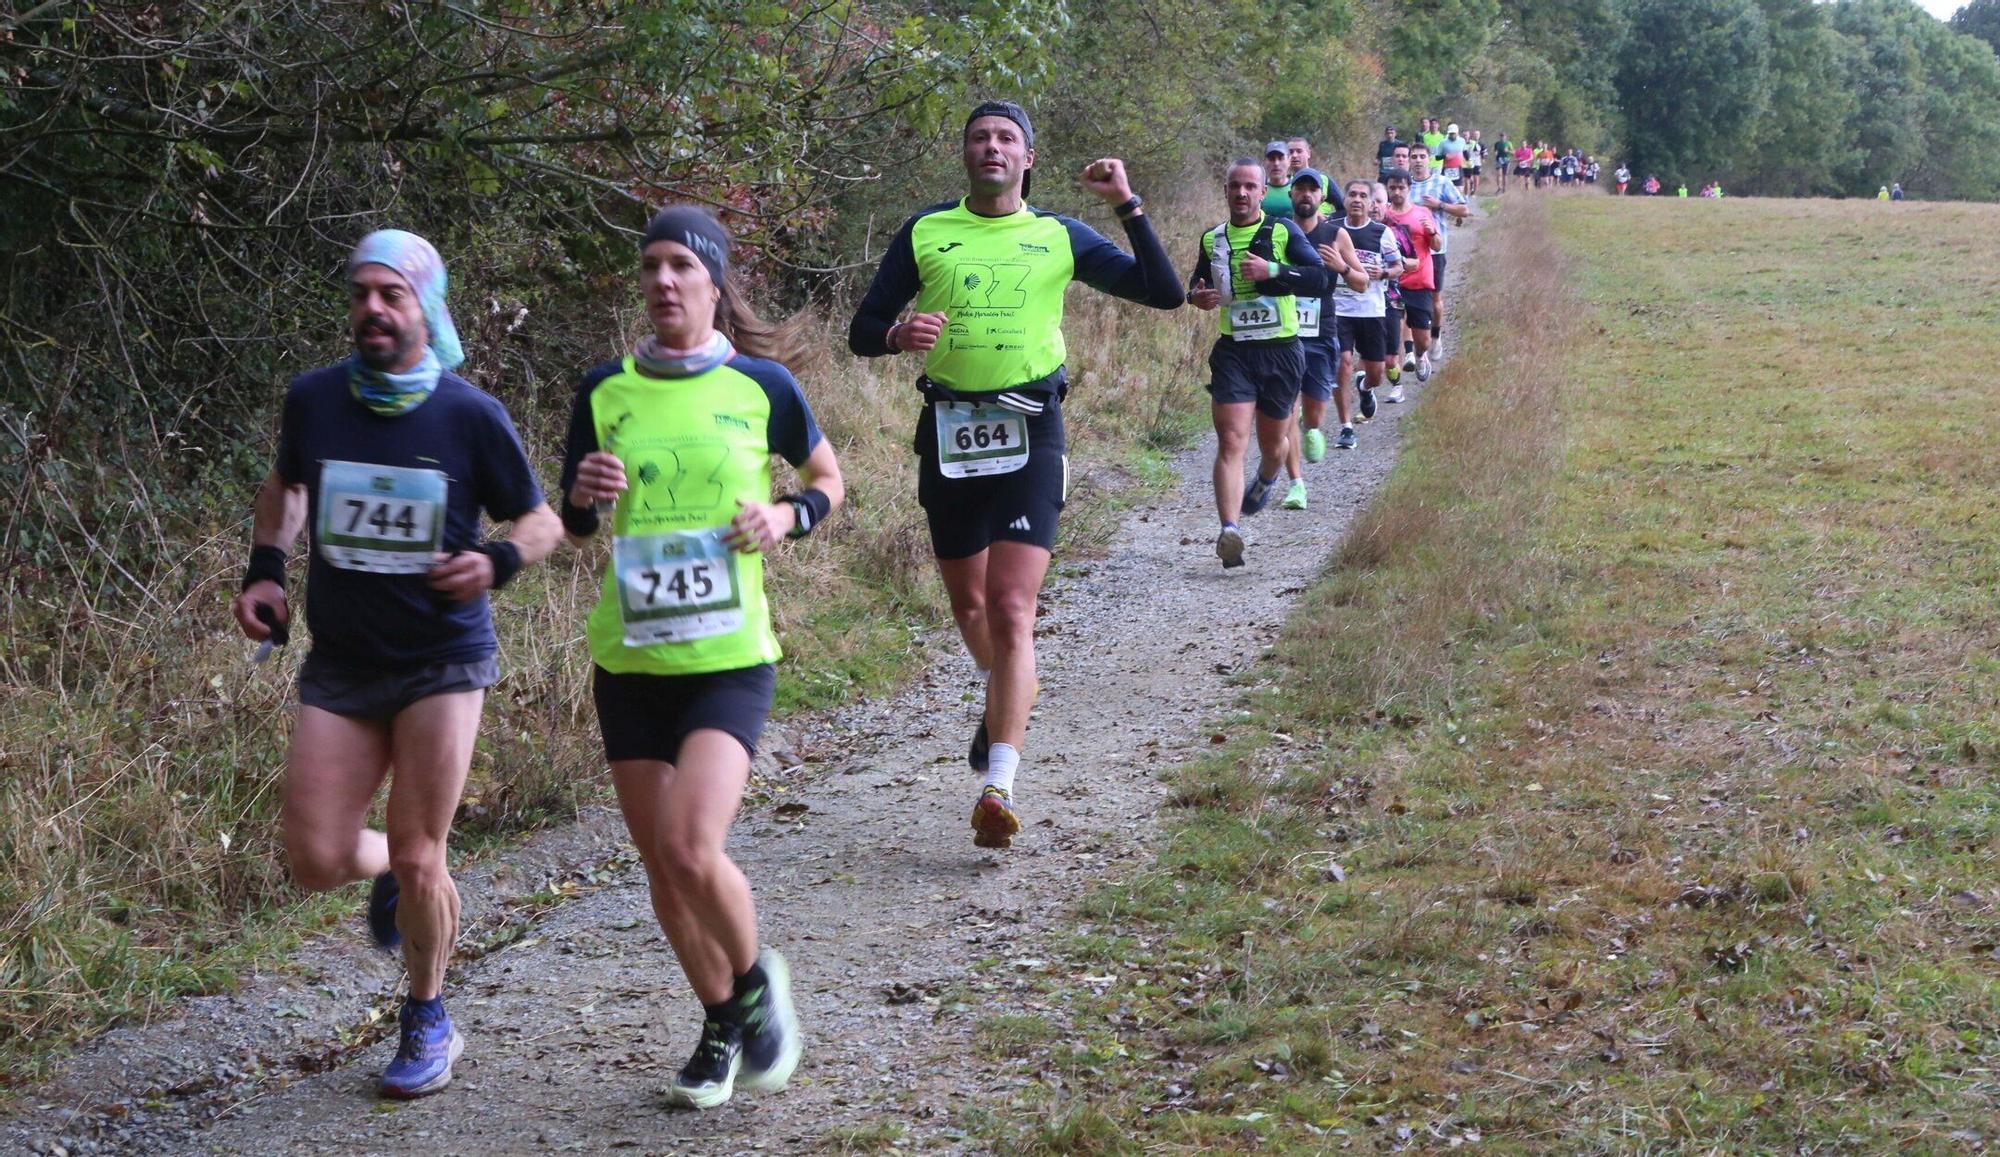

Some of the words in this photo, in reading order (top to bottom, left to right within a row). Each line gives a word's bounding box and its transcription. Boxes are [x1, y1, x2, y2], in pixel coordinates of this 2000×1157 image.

[1239, 310, 1271, 324] 442
[955, 423, 1009, 451] 664
[345, 499, 416, 538] 744
[641, 565, 713, 605] 745
